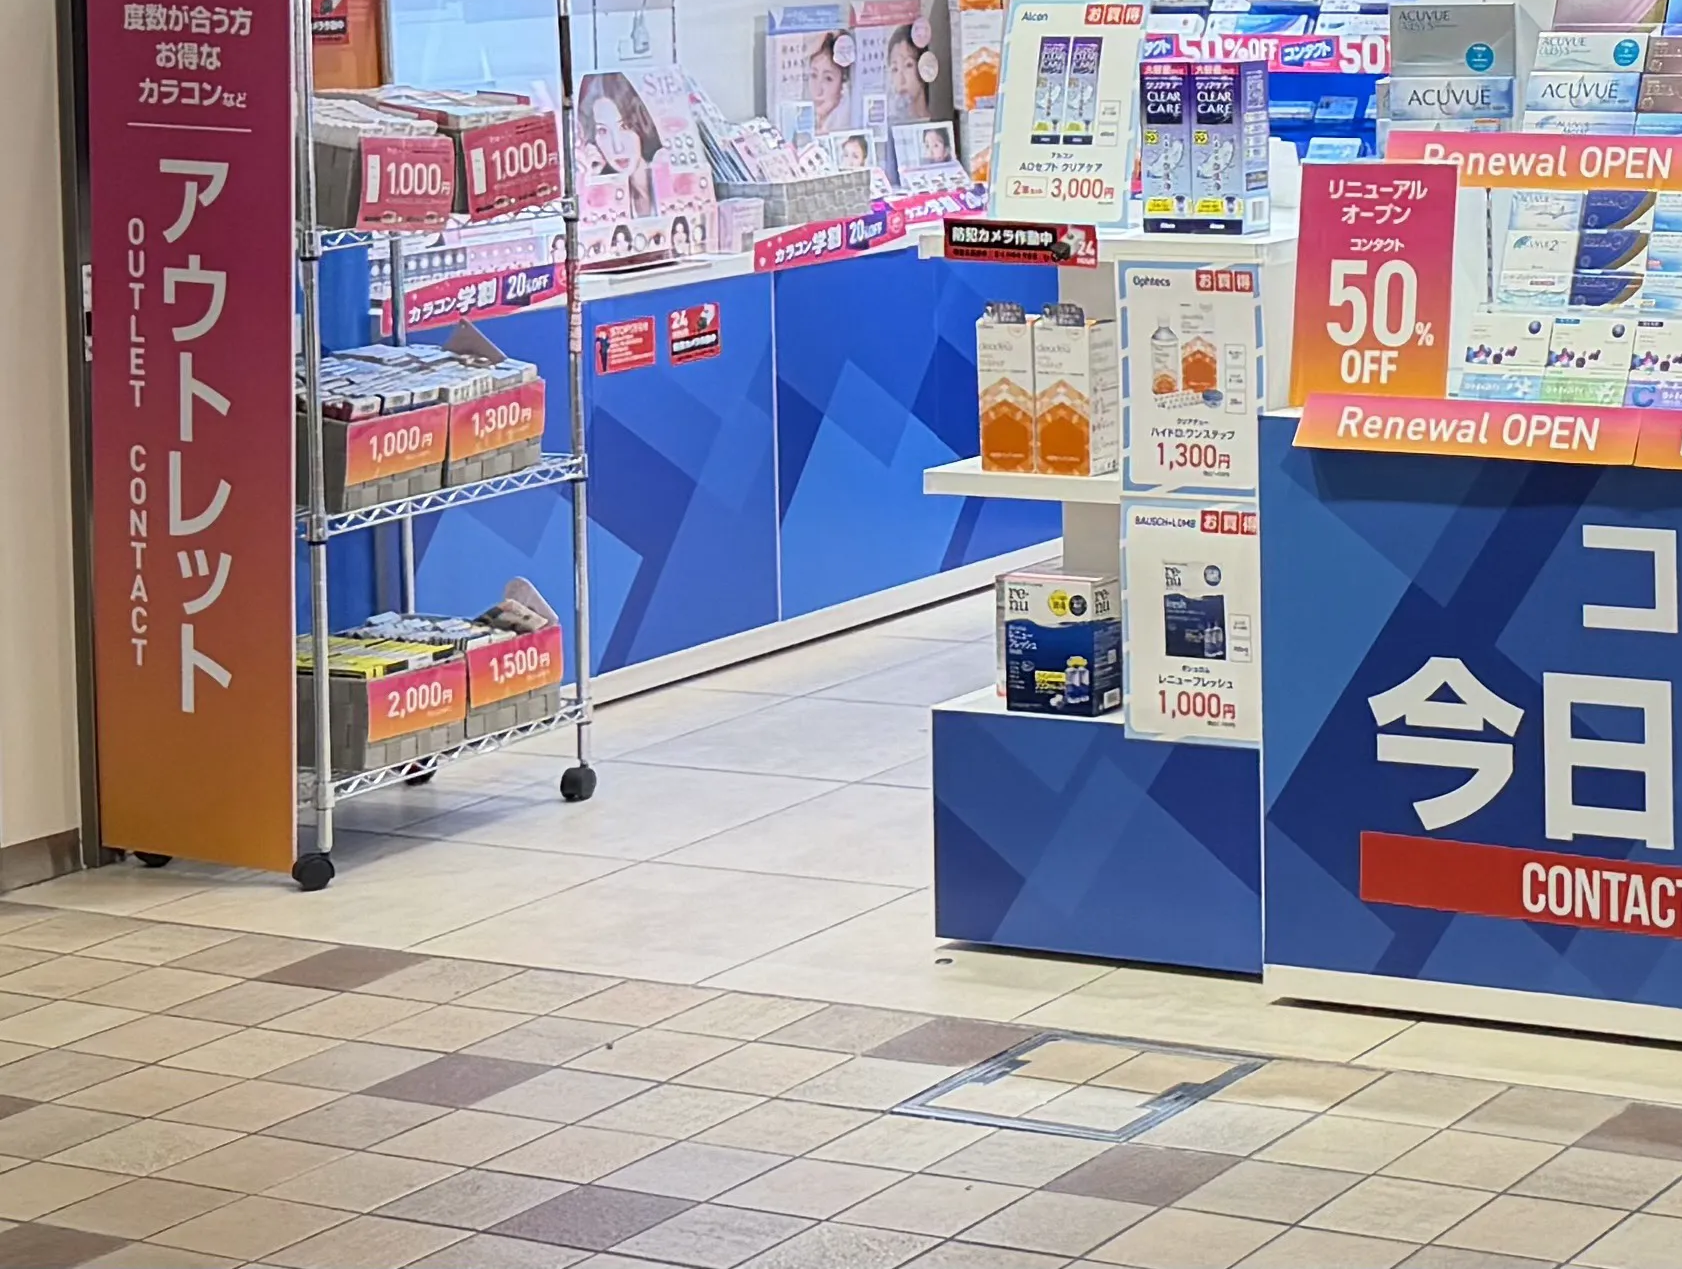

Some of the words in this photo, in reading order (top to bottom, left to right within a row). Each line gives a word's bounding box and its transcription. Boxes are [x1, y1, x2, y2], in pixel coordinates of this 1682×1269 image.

[123, 3, 253, 36] 度数が合う方
[1400, 10, 1450, 21] ACUVUE
[155, 42, 222, 71] お得な
[1283, 40, 1333, 63] コンタクト
[138, 77, 248, 109] カラコンなど
[1146, 90, 1181, 103] CLEAR
[1196, 90, 1232, 103] CLEAR
[1408, 88, 1491, 107] ACUVUE
[1541, 81, 1619, 100] ACUVUE
[1147, 103, 1181, 114] CARE
[1197, 103, 1232, 115] CARE
[491, 138, 558, 182] 1,000円
[1578, 146, 1673, 180] OPEN
[386, 162, 451, 196] 1,000円
[1050, 177, 1115, 202] 3,000円
[1328, 179, 1428, 201] リニューアル
[1341, 203, 1412, 225] オープン
[1349, 237, 1405, 252] コンタクト
[127, 217, 147, 409] OUTLET
[1326, 258, 1435, 348] 50%
[1340, 349, 1400, 384] OFF
[471, 401, 532, 439] 1,300円
[1336, 405, 1491, 444] Renewal
[1502, 413, 1600, 451] OPEN
[159, 157, 232, 715] アウトレット
[368, 425, 433, 463] 1,000円
[1155, 442, 1231, 471] 1,300円
[129, 444, 148, 667] CONTACT
[489, 646, 551, 684] 1,500円
[387, 681, 454, 719] 2,000円
[1158, 689, 1236, 720] 1,000円
